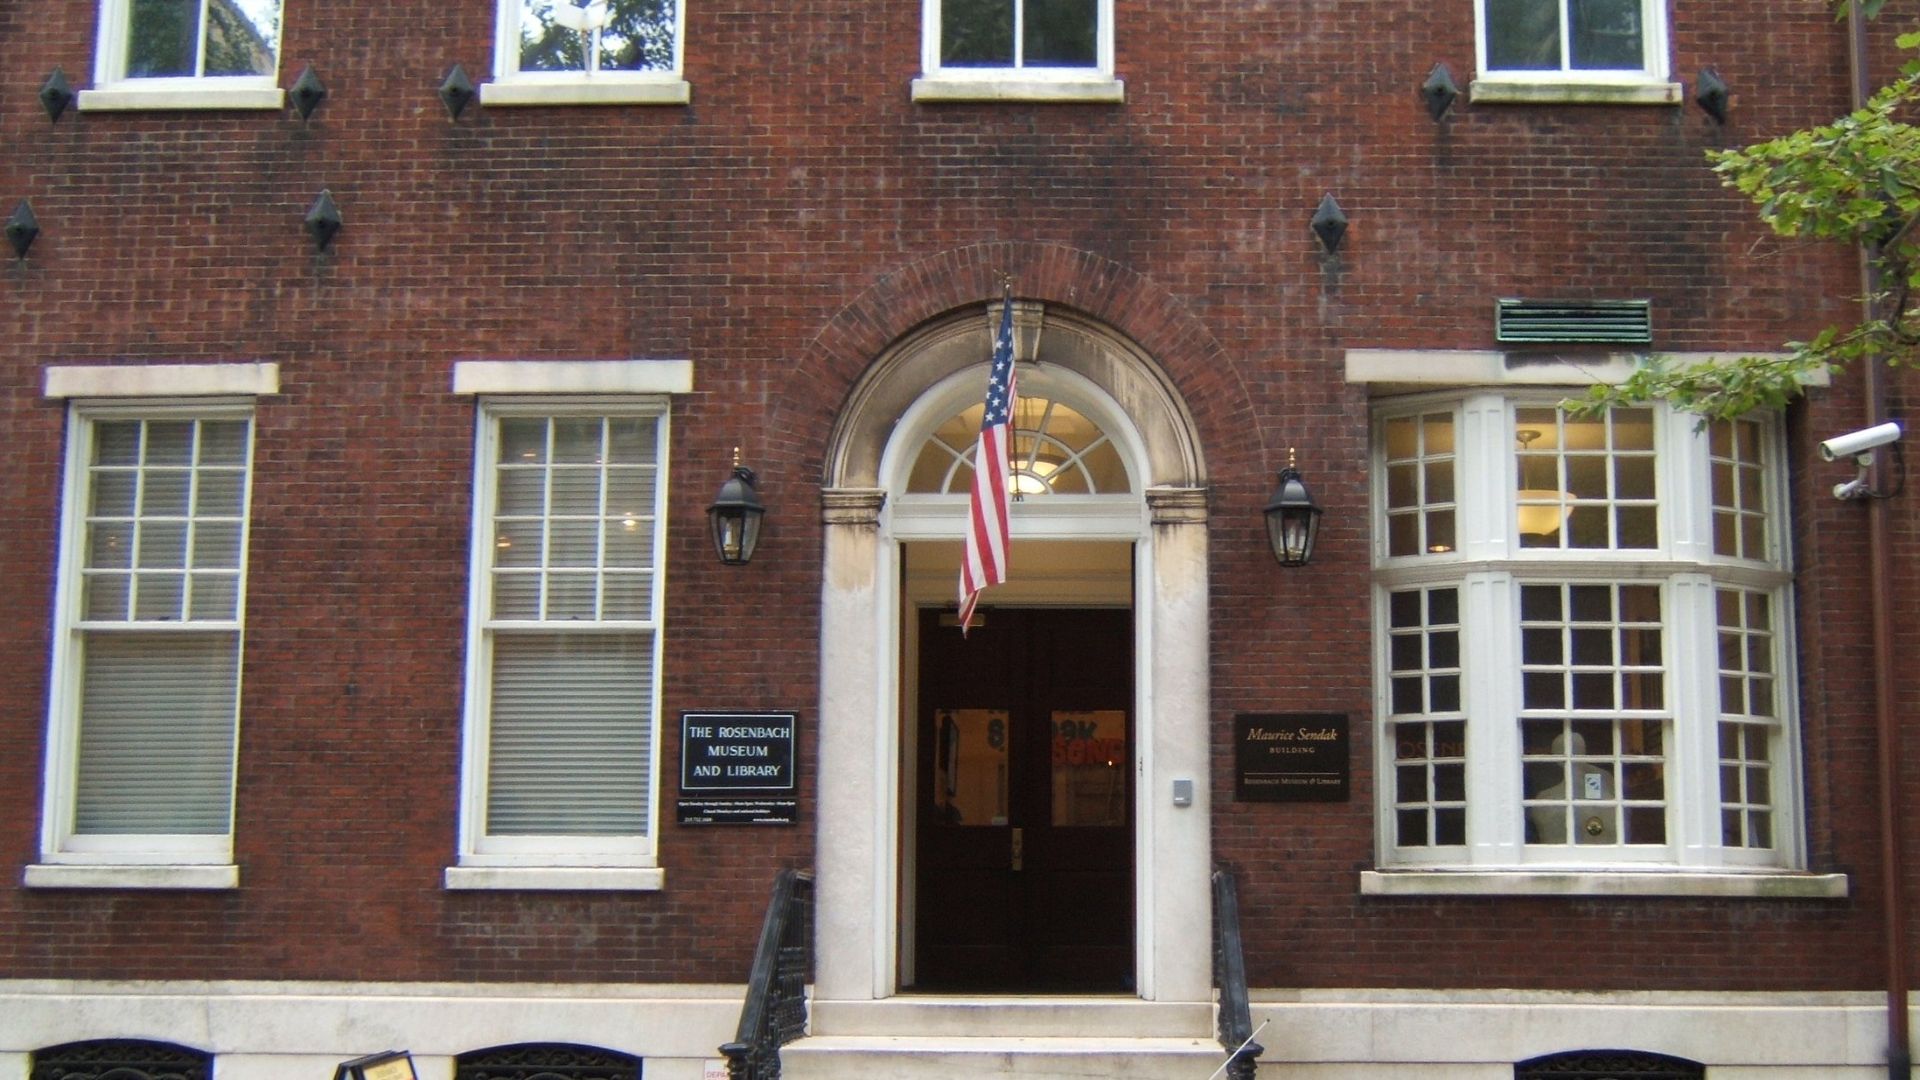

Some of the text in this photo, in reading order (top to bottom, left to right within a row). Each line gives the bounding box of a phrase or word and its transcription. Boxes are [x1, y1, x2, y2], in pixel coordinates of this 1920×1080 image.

[689, 726, 790, 738] THE ROSENBACH
[1247, 727, 1338, 741] Maurice Sendak
[708, 745, 768, 757] MUSEUM
[693, 765, 781, 776] AND LIBRARY
